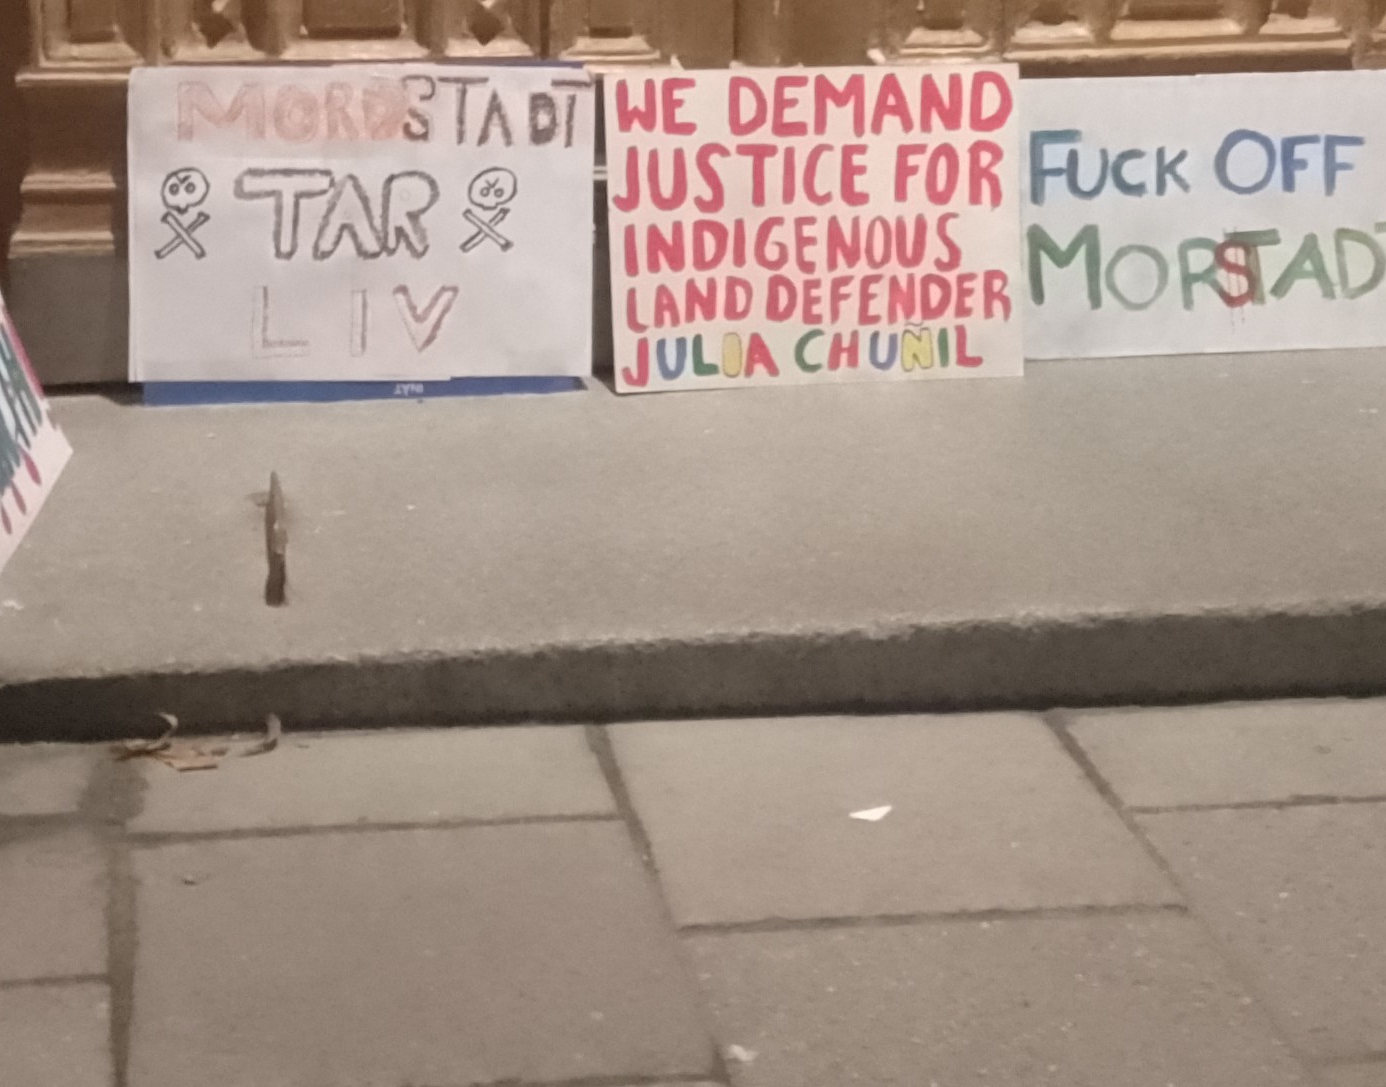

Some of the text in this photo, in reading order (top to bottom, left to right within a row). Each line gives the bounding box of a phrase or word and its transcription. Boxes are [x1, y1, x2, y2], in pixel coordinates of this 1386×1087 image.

[615, 70, 1013, 138] WE DEMAND
[612, 139, 1004, 214] JUSTICE FOR
[1028, 128, 1366, 205] FUCK OFF
[233, 167, 440, 261] TAR
[623, 212, 962, 277] INDIGENOUS
[251, 284, 460, 359] LIV
[625, 269, 1012, 334] LAND DEFENDER
[621, 320, 984, 387] JULIA CHUÑIL
